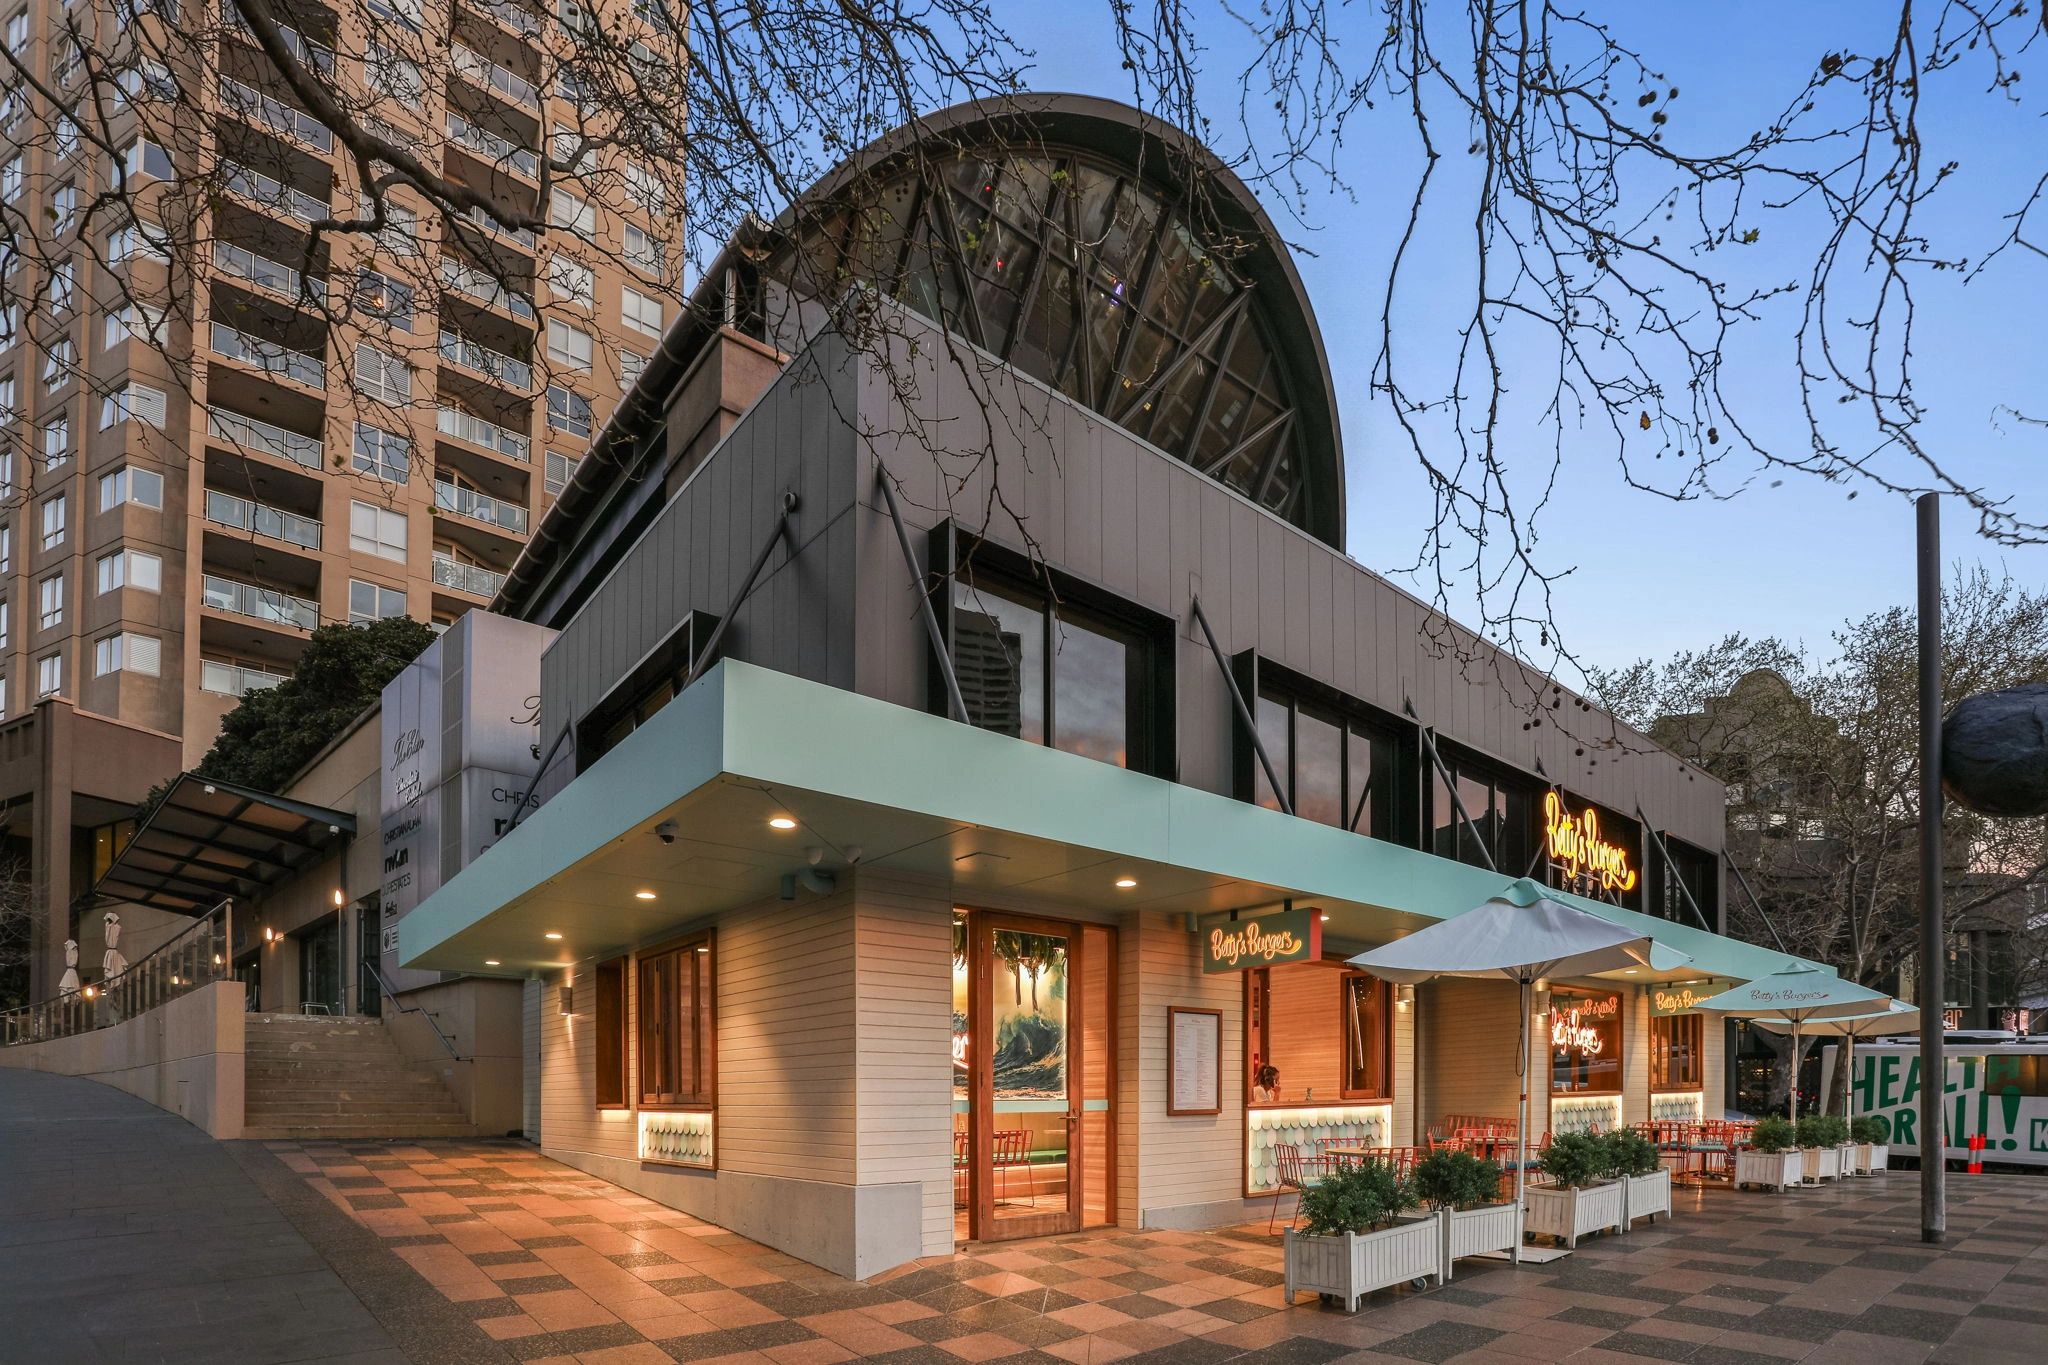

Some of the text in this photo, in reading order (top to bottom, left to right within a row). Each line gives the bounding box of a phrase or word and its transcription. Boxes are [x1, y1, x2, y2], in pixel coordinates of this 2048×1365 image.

[1545, 791, 1636, 890] Betty's Burgers
[1211, 922, 1302, 965] Betty's Burgers
[1655, 991, 1683, 1013] Betty's
[1750, 989, 1829, 1002] Betty's Burgers
